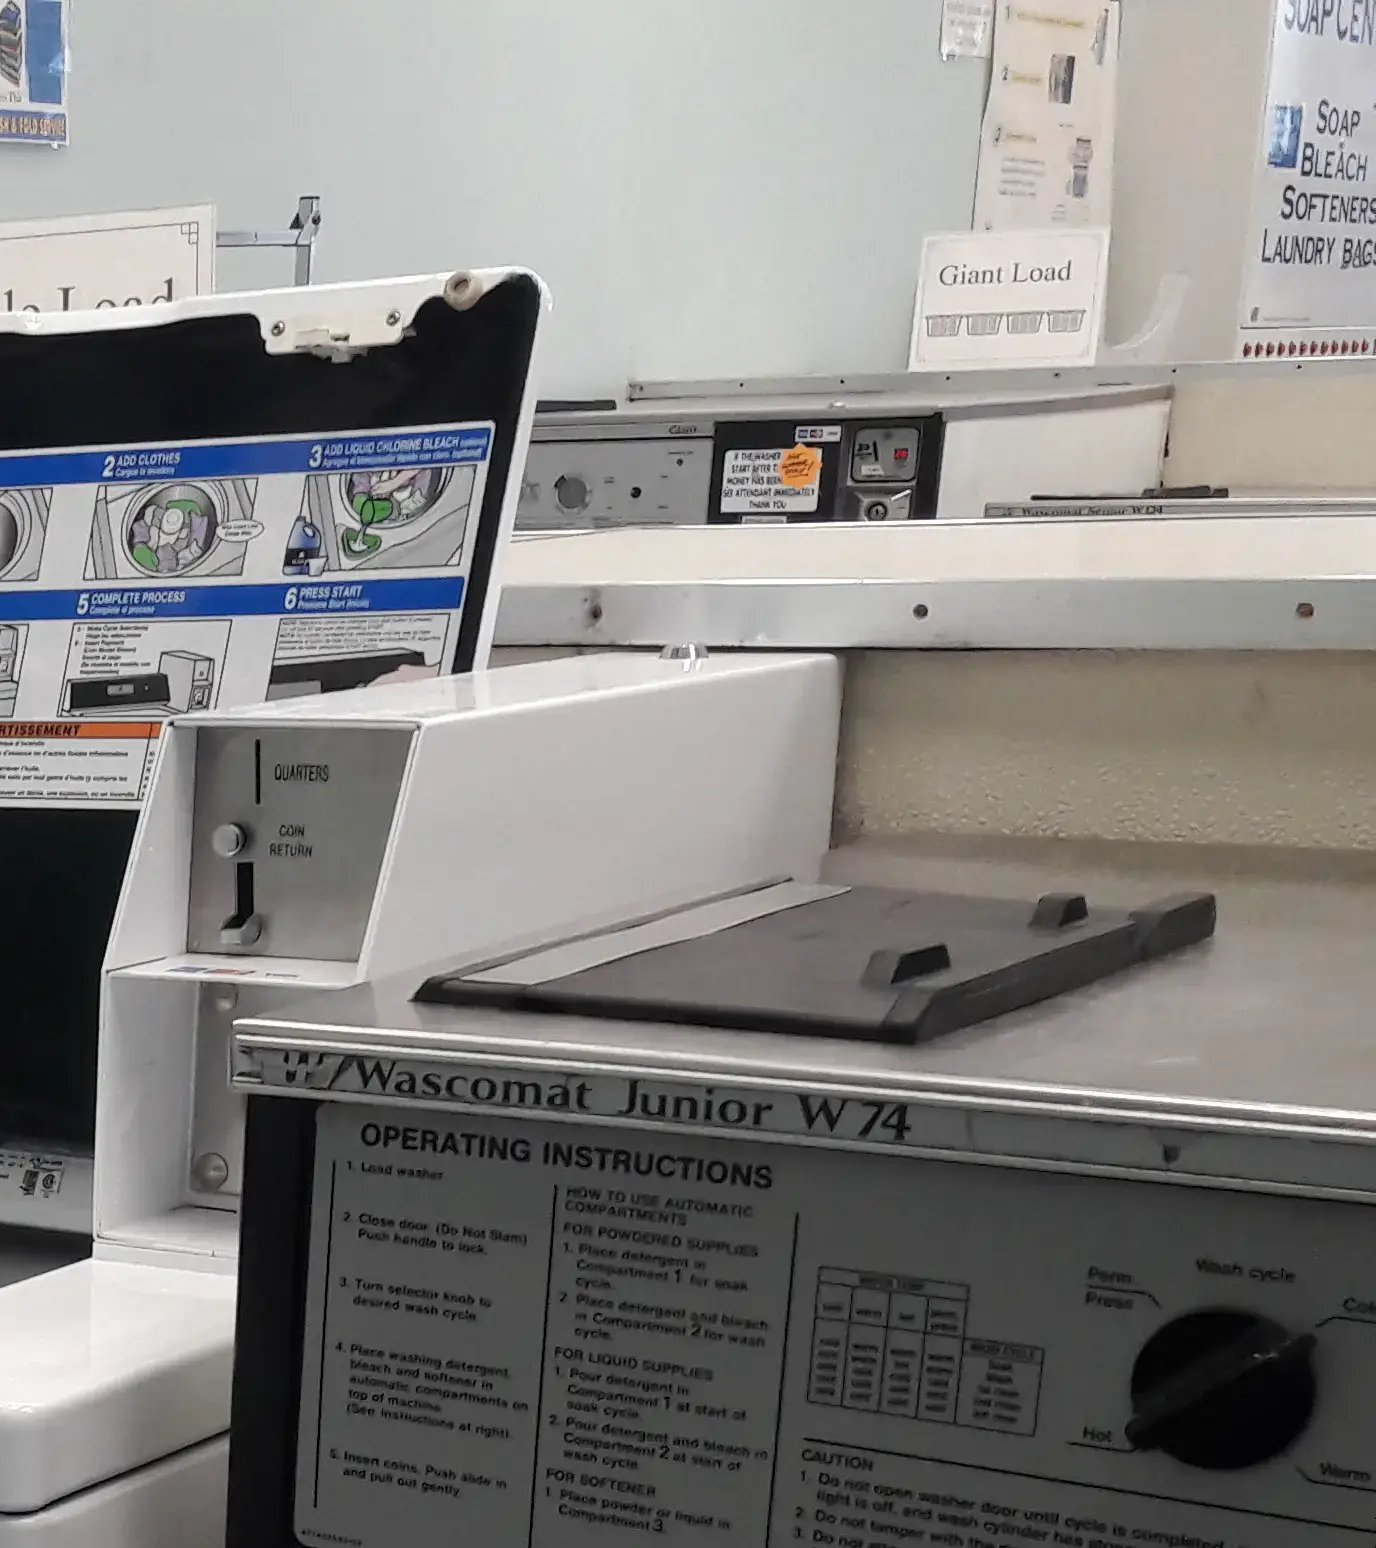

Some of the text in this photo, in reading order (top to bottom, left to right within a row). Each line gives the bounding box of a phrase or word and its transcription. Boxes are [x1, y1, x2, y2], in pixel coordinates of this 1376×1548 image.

[1316, 99, 1361, 138] SOAP
[1301, 142, 1368, 181] BLEACH
[1282, 184, 1376, 224] SOFTENERS
[1262, 228, 1336, 265] LAUNDRY
[939, 259, 1072, 286] Giant Load
[309, 436, 460, 468] 3 ADD LIQUID CHLORINE BLEACH
[101, 452, 181, 478] 2 ADD CLOTHES
[77, 590, 185, 615] 5 COMPLETE PROCESS
[285, 585, 363, 610] 6 PRESS START
[274, 763, 330, 783] QUARTERS
[278, 824, 305, 838] COIN
[268, 843, 313, 858] RETURN
[352, 1058, 593, 1110] Wascomat
[616, 1079, 773, 1126] Junior
[361, 1122, 774, 1190] OPERATING INSTRUCTIONS
[358, 1212, 395, 1227] Close
[358, 1227, 438, 1249] Push handle
[563, 1221, 592, 1237] FOR
[597, 1225, 682, 1247] POWDERED
[1195, 1258, 1296, 1282] Wash cycle
[355, 1278, 384, 1292] Turn
[387, 1284, 438, 1300] selector
[554, 1346, 584, 1362] FOR
[588, 1351, 638, 1370] LIQUID
[1082, 1426, 1112, 1442] Hot
[801, 1449, 873, 1472] CAUTION
[546, 1468, 656, 1497] FOR SOFTENER
